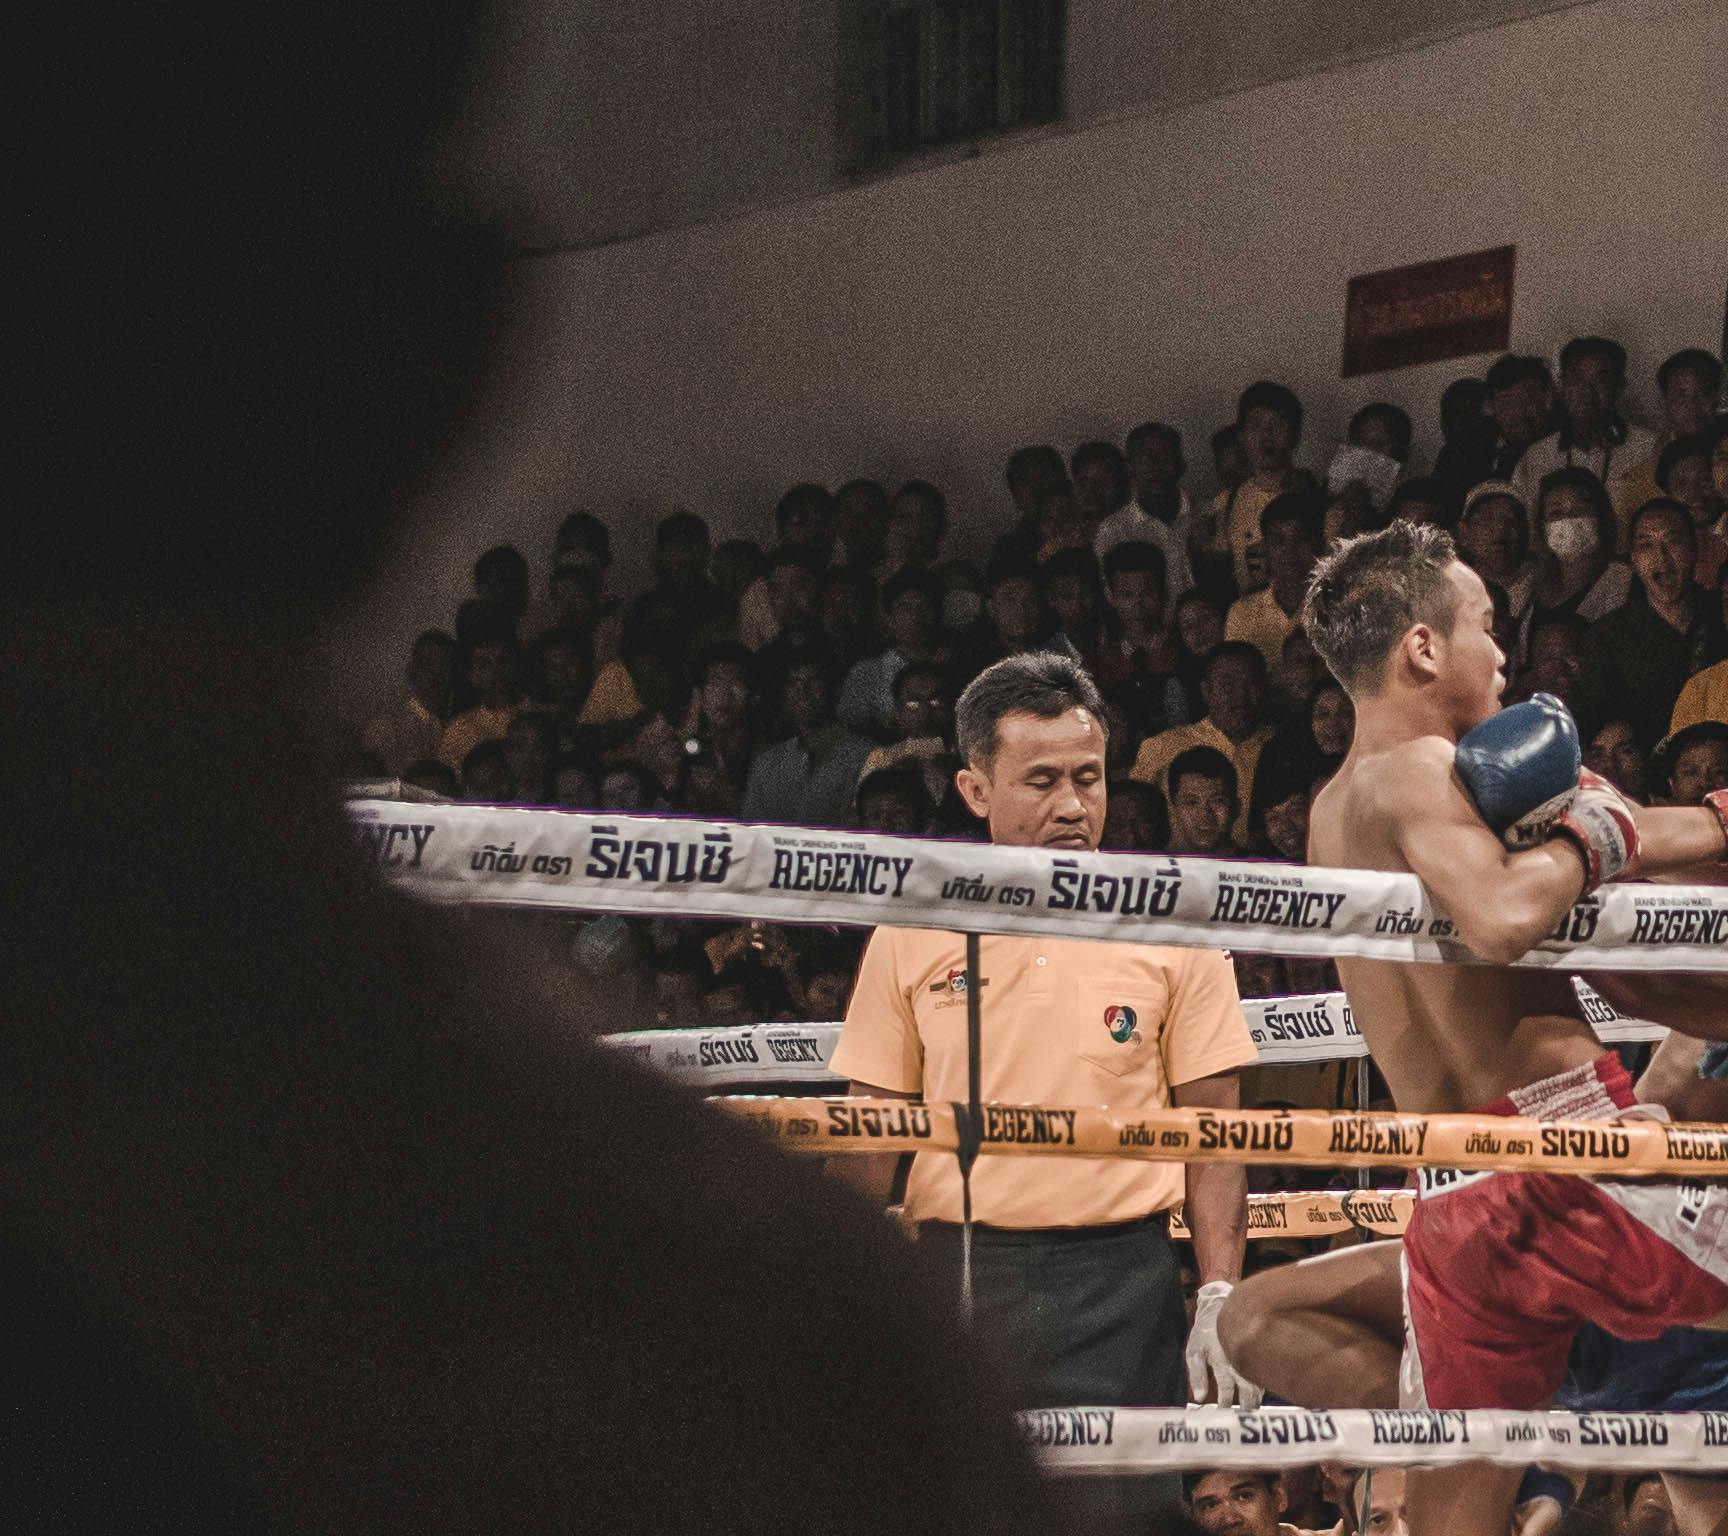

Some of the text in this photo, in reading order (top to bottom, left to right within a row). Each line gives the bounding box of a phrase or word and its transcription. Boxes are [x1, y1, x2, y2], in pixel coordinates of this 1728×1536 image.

[532, 855, 573, 876] ตรา
[768, 848, 914, 897] REGENCY
[998, 886, 1036, 906] ตรา
[1210, 884, 1346, 928] REGENCY
[1428, 919, 1460, 937] ตร
[766, 1038, 824, 1063] REGENCY
[980, 1107, 1076, 1145] EGENCY
[1160, 1129, 1189, 1146] ตรา
[1328, 1117, 1428, 1156] REGENCY
[1505, 1140, 1534, 1155] ตรา
[1247, 1202, 1288, 1228] EGENCY
[1368, 1409, 1471, 1445] REGENCY
